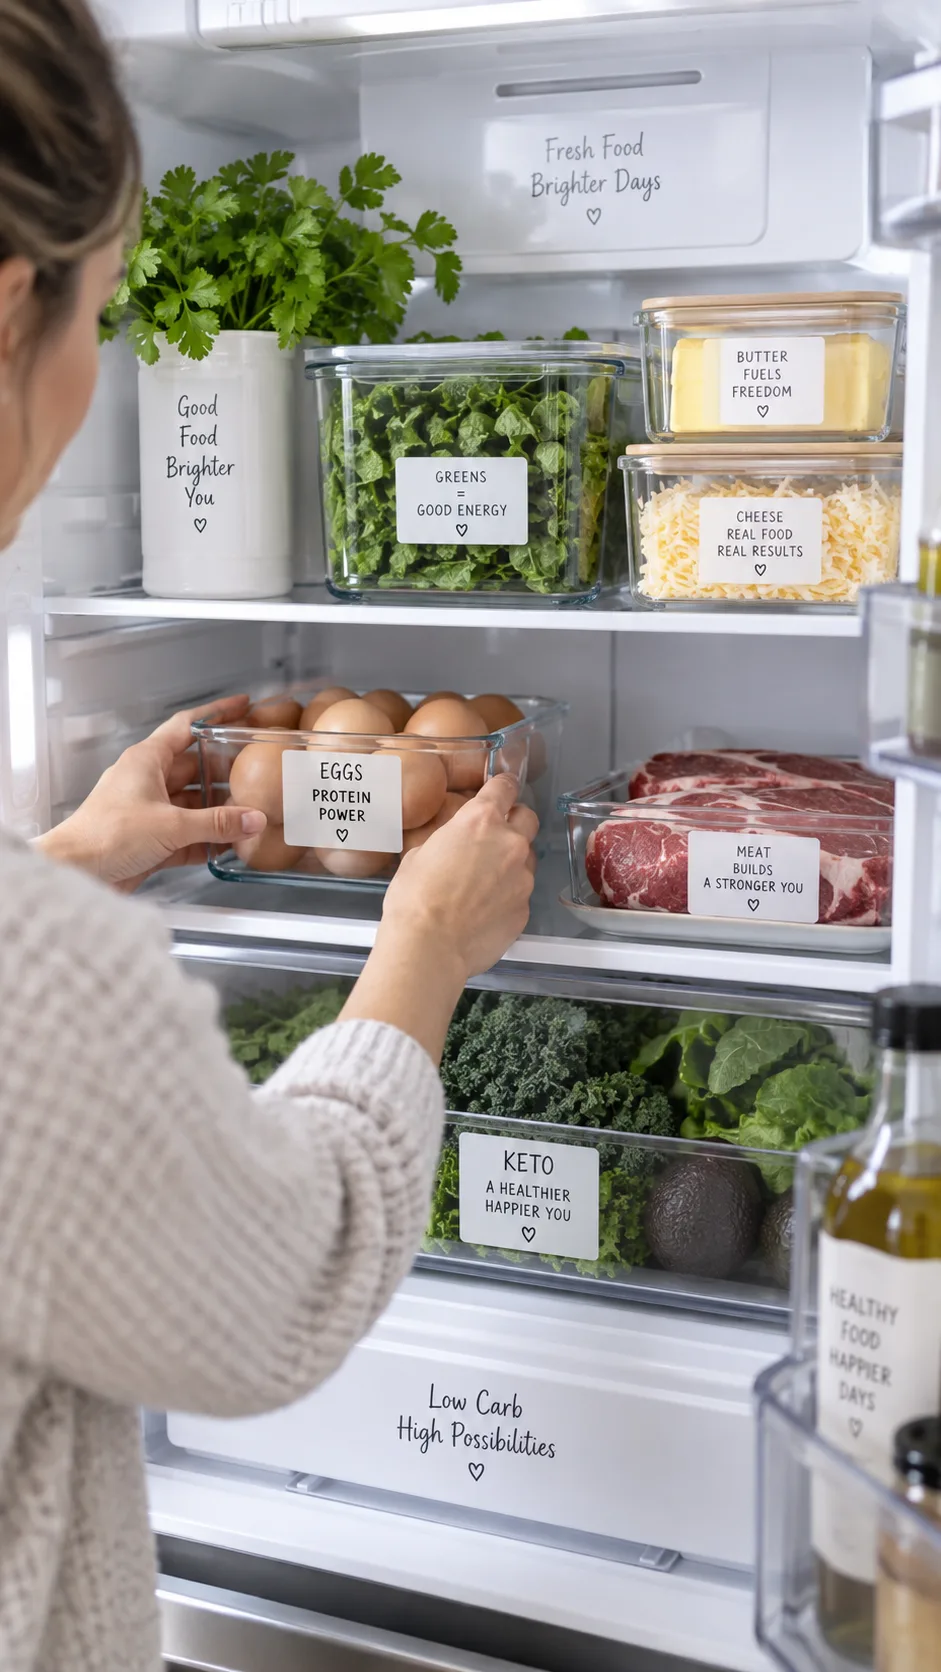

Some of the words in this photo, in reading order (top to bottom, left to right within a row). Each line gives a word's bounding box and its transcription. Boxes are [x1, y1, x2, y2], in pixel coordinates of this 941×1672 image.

[545, 135, 595, 163] Fresh
[602, 131, 644, 160] Food
[530, 169, 608, 206] Brighter
[614, 168, 661, 202] Days
[737, 350, 788, 364] BUTTER
[743, 368, 782, 381] FUELS
[732, 385, 792, 398] FREEDOM
[177, 393, 218, 419] Good
[179, 423, 218, 448] Food
[165, 454, 235, 487] Brighter
[435, 470, 487, 484] GREENS
[184, 486, 215, 508] You
[417, 503, 453, 517] GOOD
[457, 503, 507, 517] ENERGY
[736, 510, 784, 523] CHEESE
[727, 528, 756, 541] REAL
[761, 528, 793, 541] FOOD
[717, 544, 747, 557] REAL
[752, 544, 804, 558] RESULTS
[320, 761, 363, 782] EGGS
[312, 788, 371, 804] PROTEIN
[319, 807, 366, 822] POWER
[736, 845, 772, 859] MEAT
[733, 862, 773, 876] BUILDS
[703, 877, 712, 889] A
[715, 877, 776, 893] STRONGER
[780, 881, 804, 894] YOU
[504, 1149, 554, 1176] KETO
[485, 1180, 495, 1194] A
[499, 1182, 571, 1203] HEALTHIER
[485, 1199, 541, 1219] HAPPIER
[545, 1206, 571, 1222] YOU
[829, 1286, 899, 1326] HEALTHY
[840, 1319, 881, 1351] FOOD
[829, 1347, 892, 1388] HAPPIER
[428, 1382, 467, 1411] Low
[476, 1388, 523, 1419] Carb
[838, 1380, 876, 1412] DAYS
[396, 1414, 444, 1455] High
[450, 1419, 556, 1460] Possibilities
